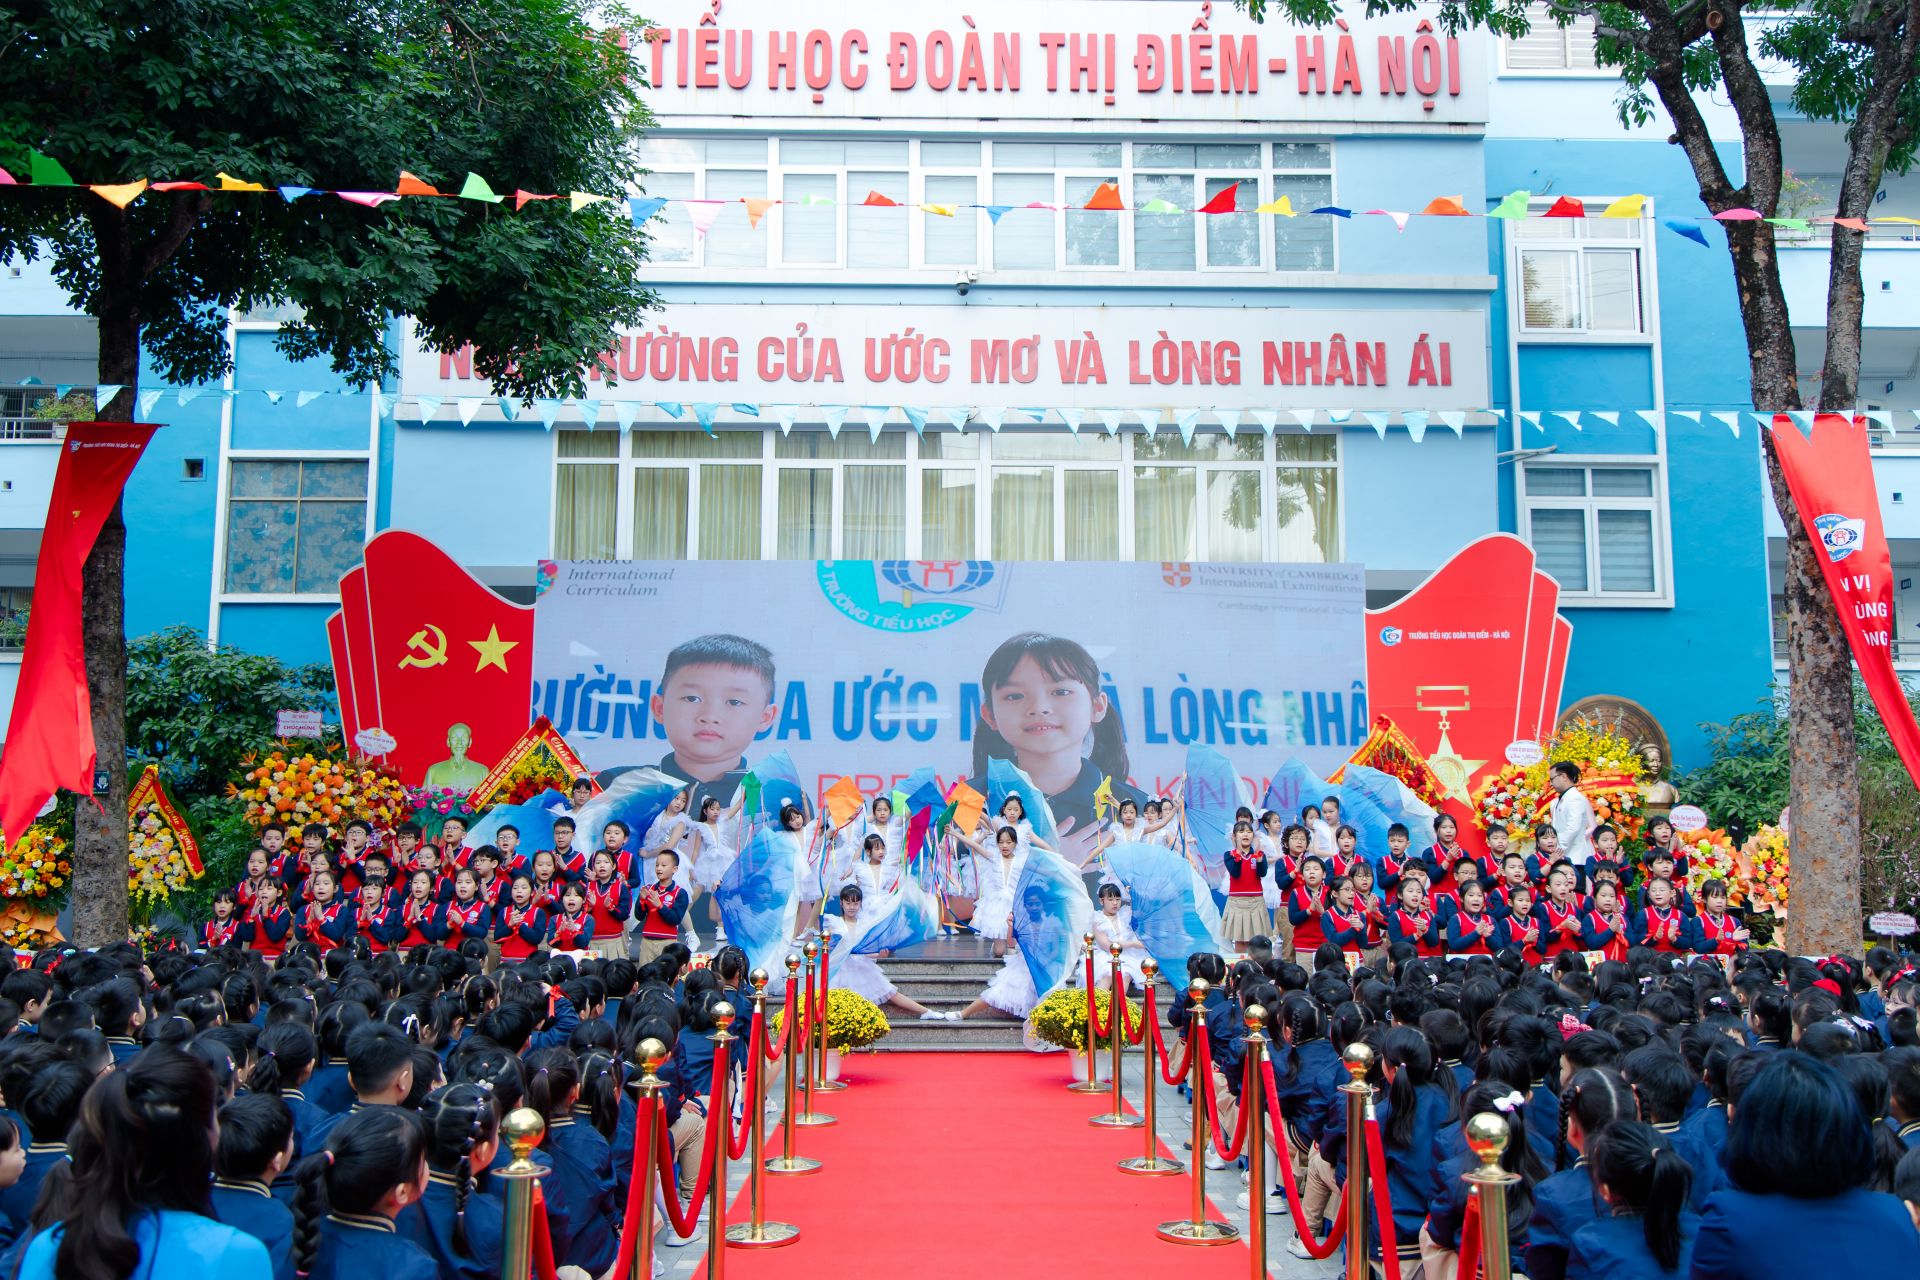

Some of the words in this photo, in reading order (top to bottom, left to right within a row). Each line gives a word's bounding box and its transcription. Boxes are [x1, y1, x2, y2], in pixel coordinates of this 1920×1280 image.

[645, 0, 752, 89] TIỂU
[768, 29, 868, 103] HỌC
[887, 15, 1020, 91] ĐOÀN
[1039, 33, 1115, 105] THỊ
[1378, 19, 1460, 111] NỘI
[757, 322, 844, 383] CỦA
[864, 327, 950, 384] ƯỚC
[970, 333, 1041, 384] MƠ
[1054, 330, 1108, 385] VÀ
[1128, 330, 1241, 386] LÒNG
[1262, 333, 1387, 387] NHÂN
[1408, 333, 1452, 387] ÁI
[568, 568, 675, 580] International
[1198, 565, 1273, 577] UNIVERSITY
[1287, 570, 1361, 582] CAMBRIDGE
[566, 583, 658, 596] Curriculum
[1200, 576, 1278, 588] International
[1282, 580, 1364, 593] Examinations
[1853, 574, 1871, 592] VỊ
[822, 571, 869, 622] TRƯỜNG
[872, 612, 914, 630] TIỂU
[916, 609, 956, 629] HỌC
[1854, 601, 1887, 619] ÙNG
[832, 668, 938, 742] ƯỚC
